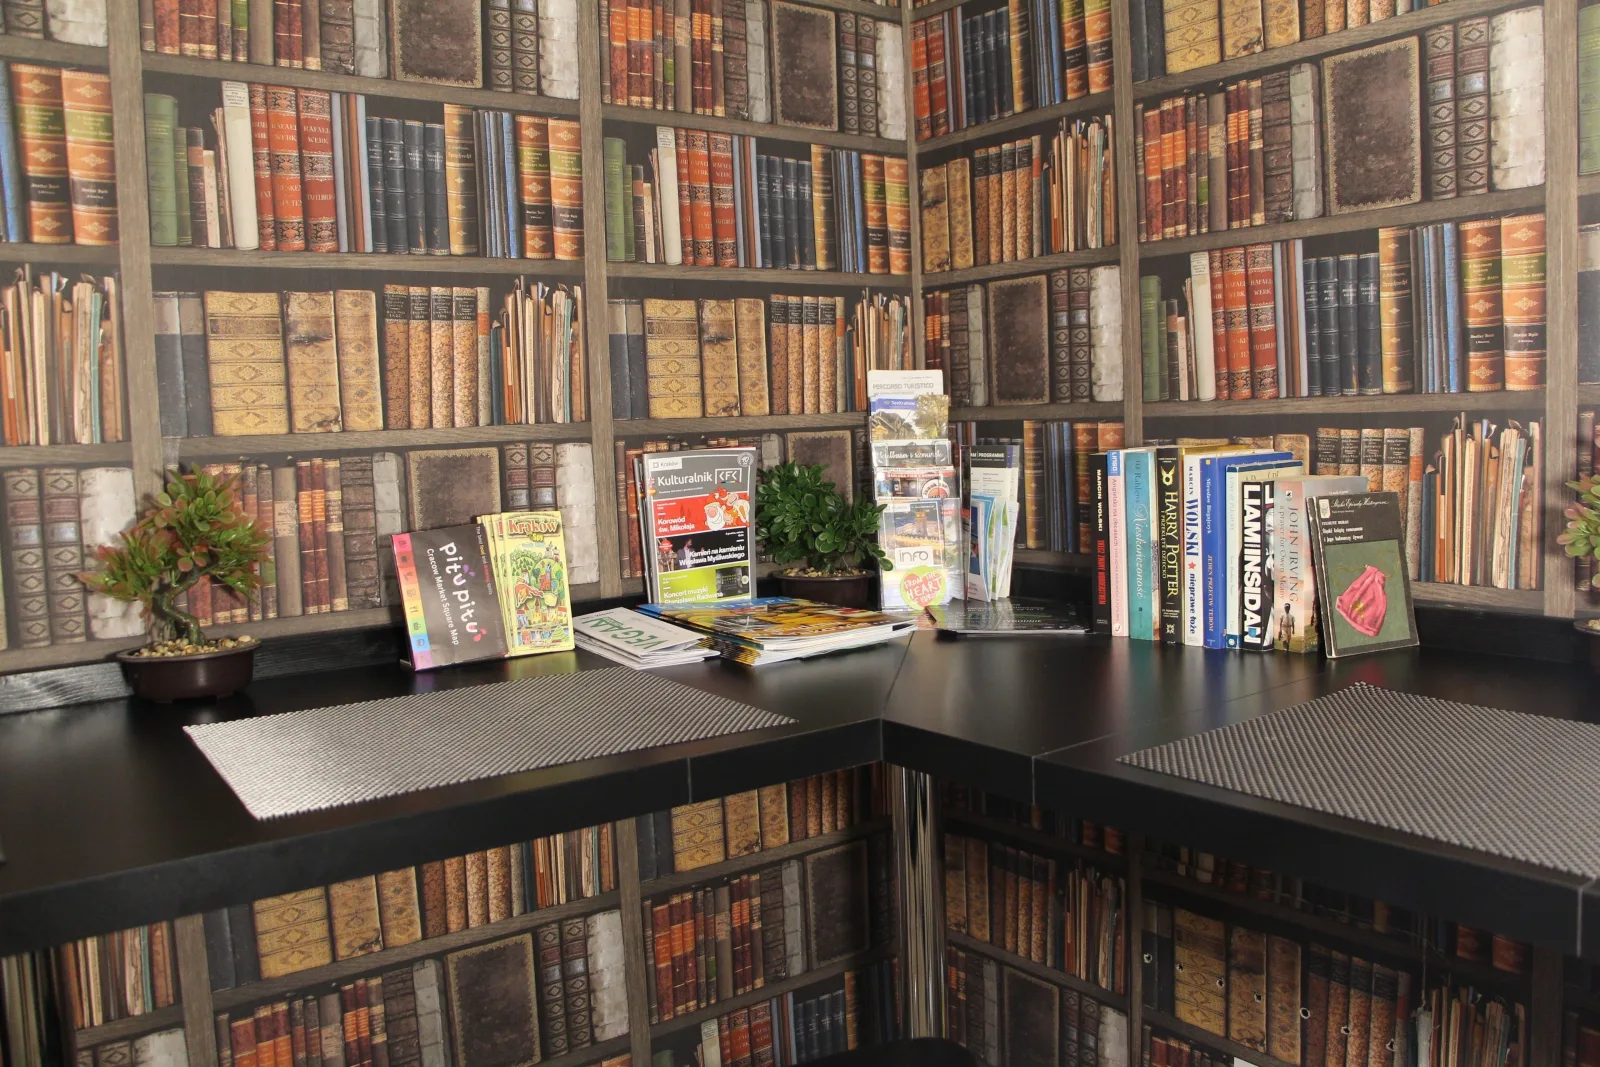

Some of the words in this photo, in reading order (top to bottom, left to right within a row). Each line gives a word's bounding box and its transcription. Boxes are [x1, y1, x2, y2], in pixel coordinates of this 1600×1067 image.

[658, 472, 713, 486] Kulturalnik
[658, 516, 686, 526] Korowód
[670, 523, 695, 532] Mikołaja
[1165, 491, 1178, 539] HARRY
[1186, 498, 1198, 557] WOLSKI
[1289, 506, 1298, 546] JOHN
[532, 533, 544, 541] Spy
[899, 550, 929, 562] info
[1132, 503, 1148, 599] Nieskończoność
[439, 542, 470, 586] pitu
[1166, 544, 1180, 598] POTTER
[1289, 550, 1299, 602] IRVING
[427, 548, 440, 576] Cracow
[435, 576, 447, 603] Market
[442, 602, 454, 629] Square
[450, 628, 460, 646] Map
[664, 590, 687, 599] Koncert
[688, 586, 708, 596] muzyki
[907, 577, 942, 600] HEART
[1278, 576, 1286, 599] Meany
[452, 589, 478, 634] pitu
